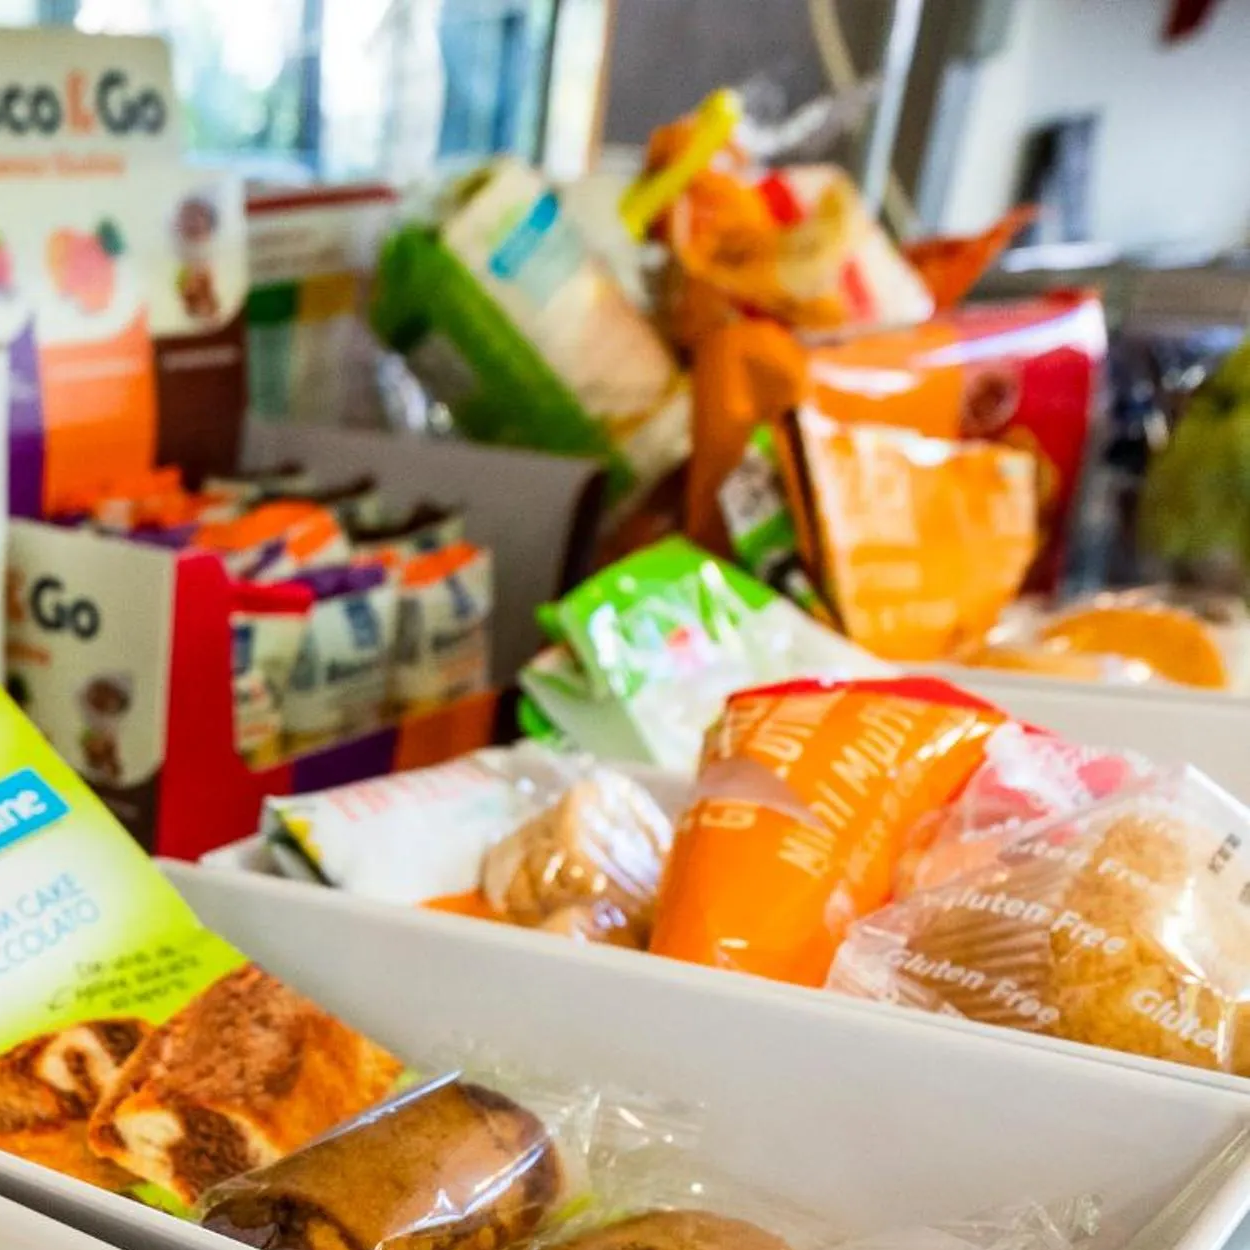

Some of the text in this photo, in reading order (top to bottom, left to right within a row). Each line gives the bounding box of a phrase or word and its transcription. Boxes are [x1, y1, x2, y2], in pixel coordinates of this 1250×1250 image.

[16, 871, 87, 919] CAKE
[1051, 909, 1128, 955] Free
[884, 946, 1061, 1024] Gluten Free
